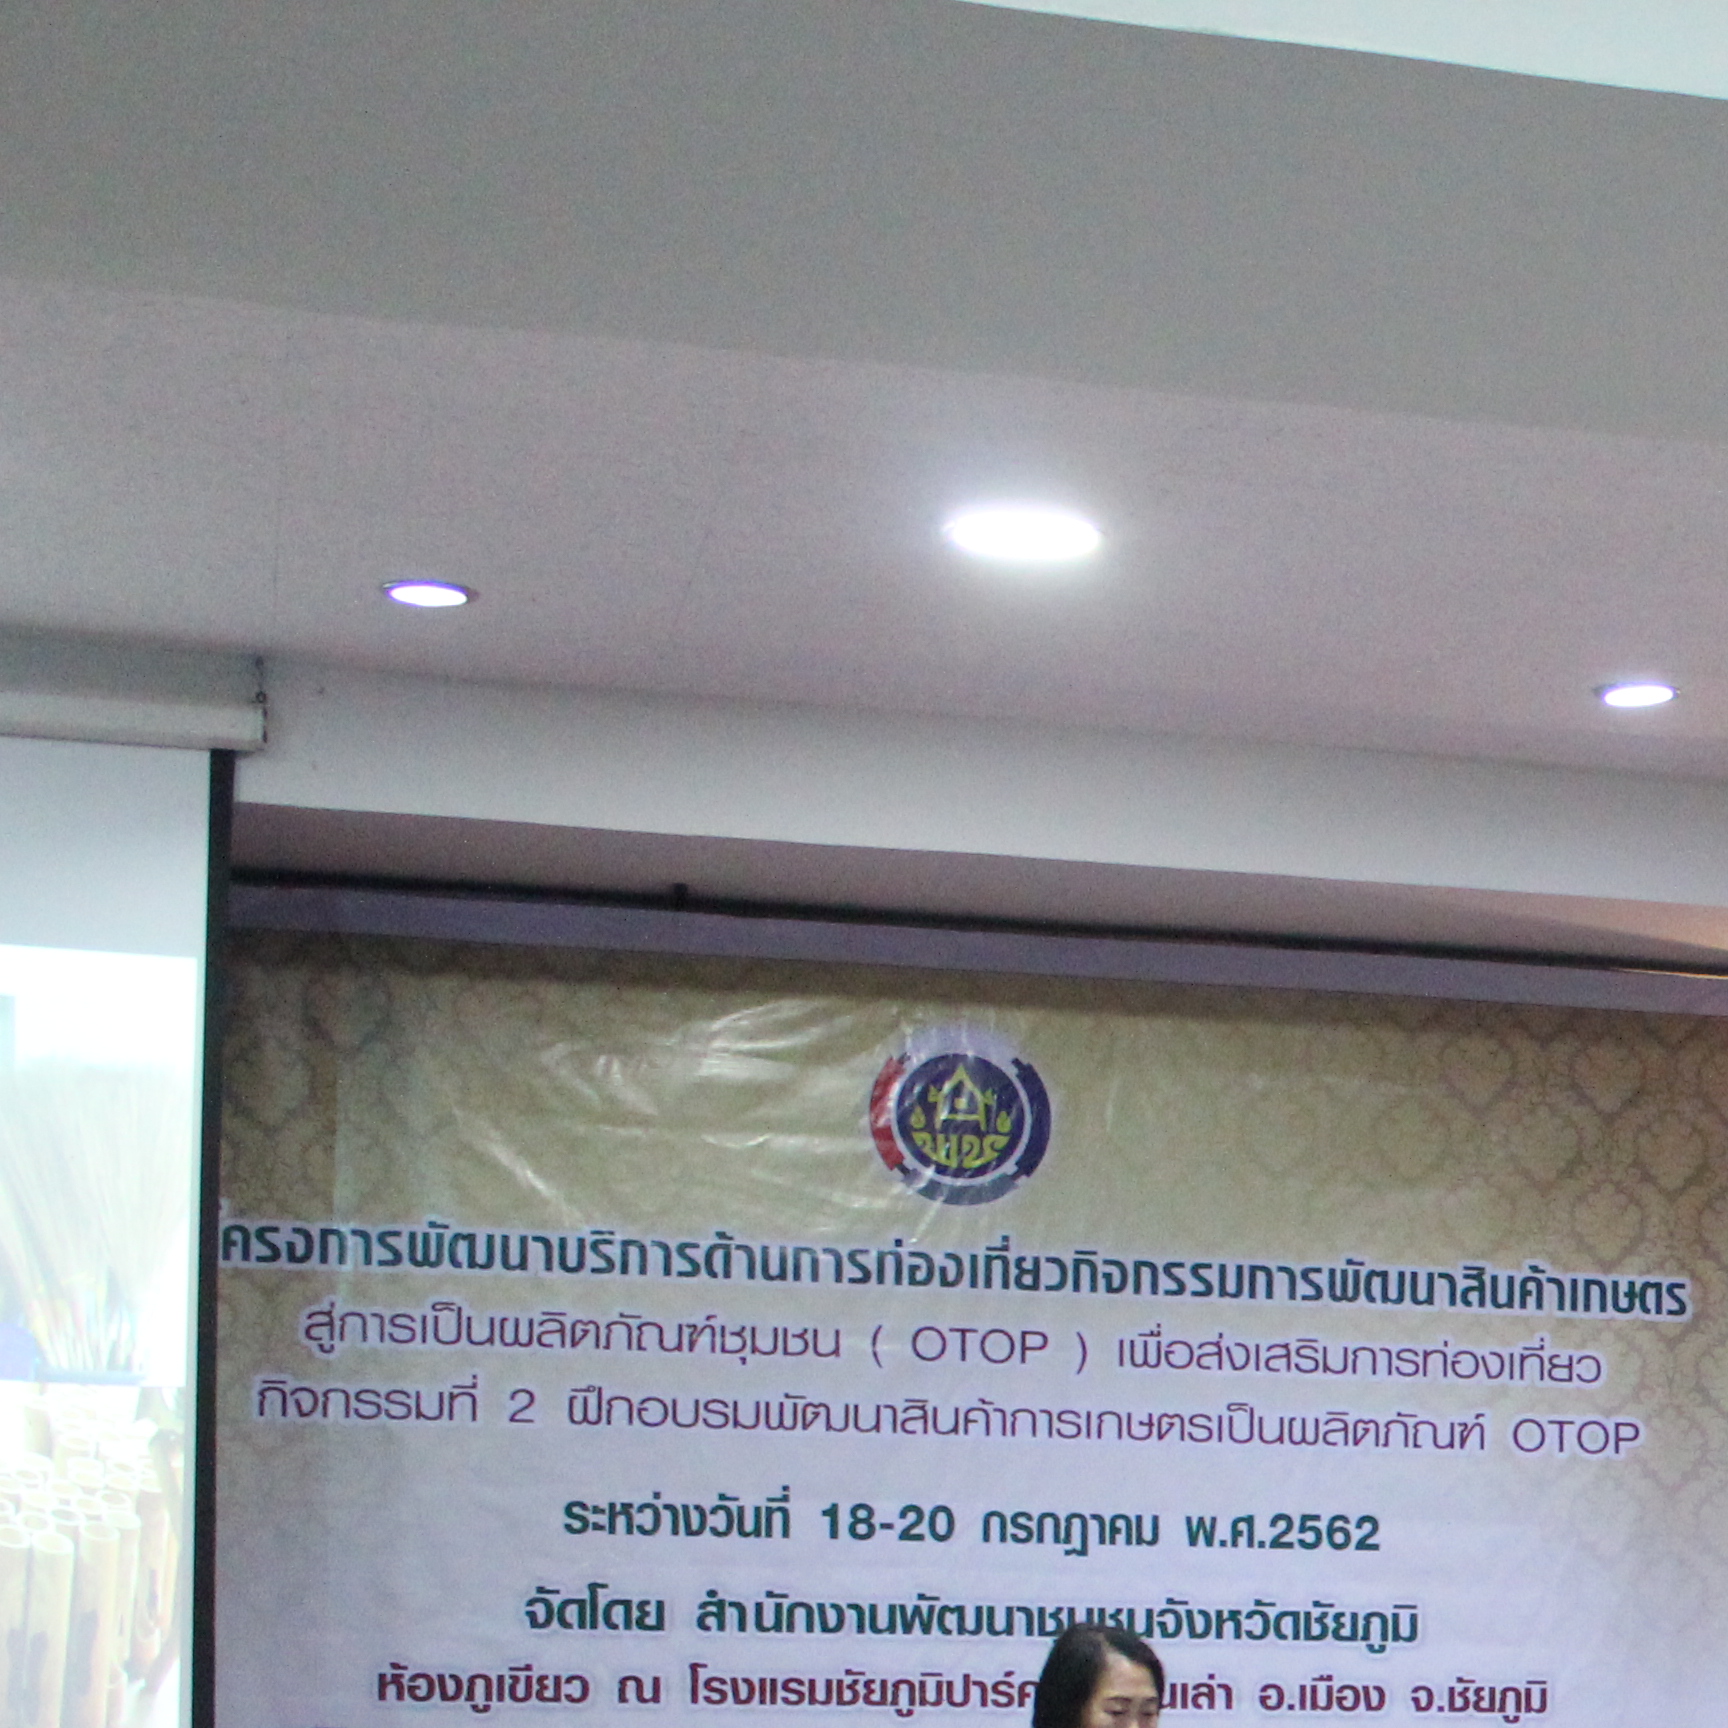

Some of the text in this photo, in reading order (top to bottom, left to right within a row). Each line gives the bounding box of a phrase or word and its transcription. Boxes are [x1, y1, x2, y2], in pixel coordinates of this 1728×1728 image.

[221, 1220, 1688, 1317] ครงการพัฒนาบริการด้านการท่องเที่ยวกิจกรรมการพัฒนาสินค้าเกษตร
[304, 1301, 841, 1366] สู่การเป็นผลิตภัณฑ์ชุมชน
[910, 1325, 1049, 1365] OTOP
[1118, 1323, 1602, 1385] เพื่อส่งเสริมการท่องเที่ยว
[257, 1376, 1640, 1455] กิจกรรมที่ 2 ฝึกอบรมพัฒนาสินค้าการเกษตรเป็นผลิตภัณฑ์ OTOP
[563, 1485, 1381, 1557] ระหว่างวันที่ 18-20 กรกฎาคม พ.ศ.2562
[524, 1582, 666, 1632] จัดโดย
[377, 1661, 591, 1714] ห้องภูเขียว
[617, 1674, 662, 1705] ณ
[1257, 1673, 1387, 1713] อ.เมือง
[1410, 1676, 1548, 1724] จ.ชัยภูมิ
